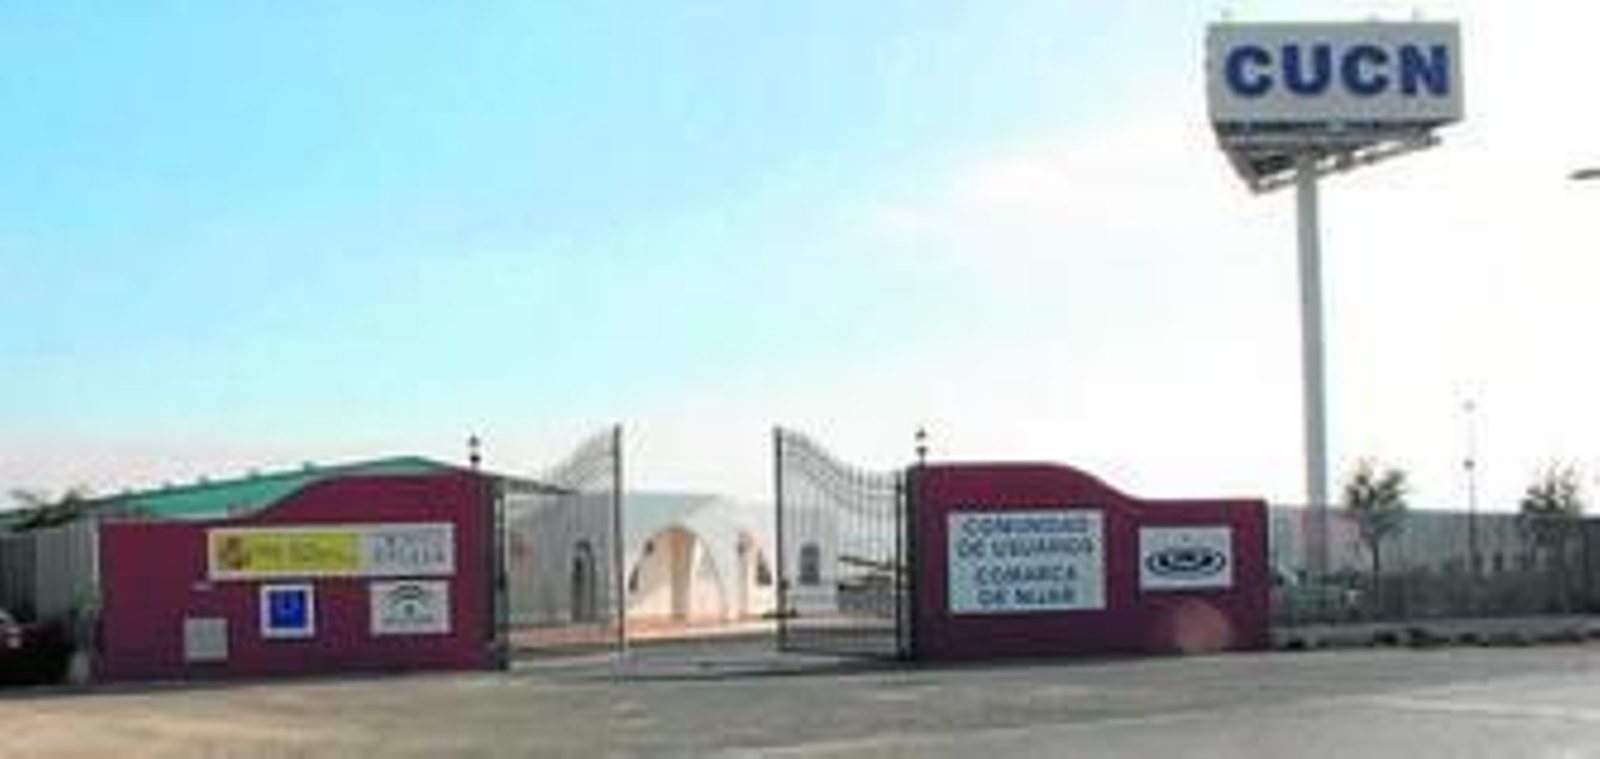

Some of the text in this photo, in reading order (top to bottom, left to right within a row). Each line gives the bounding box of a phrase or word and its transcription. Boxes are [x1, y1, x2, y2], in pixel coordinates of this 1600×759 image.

[1225, 44, 1451, 97] CUCN
[957, 537, 1094, 557] DE USUARIOS
[975, 565, 1077, 585] COMARCA
[979, 589, 1006, 606] DE
